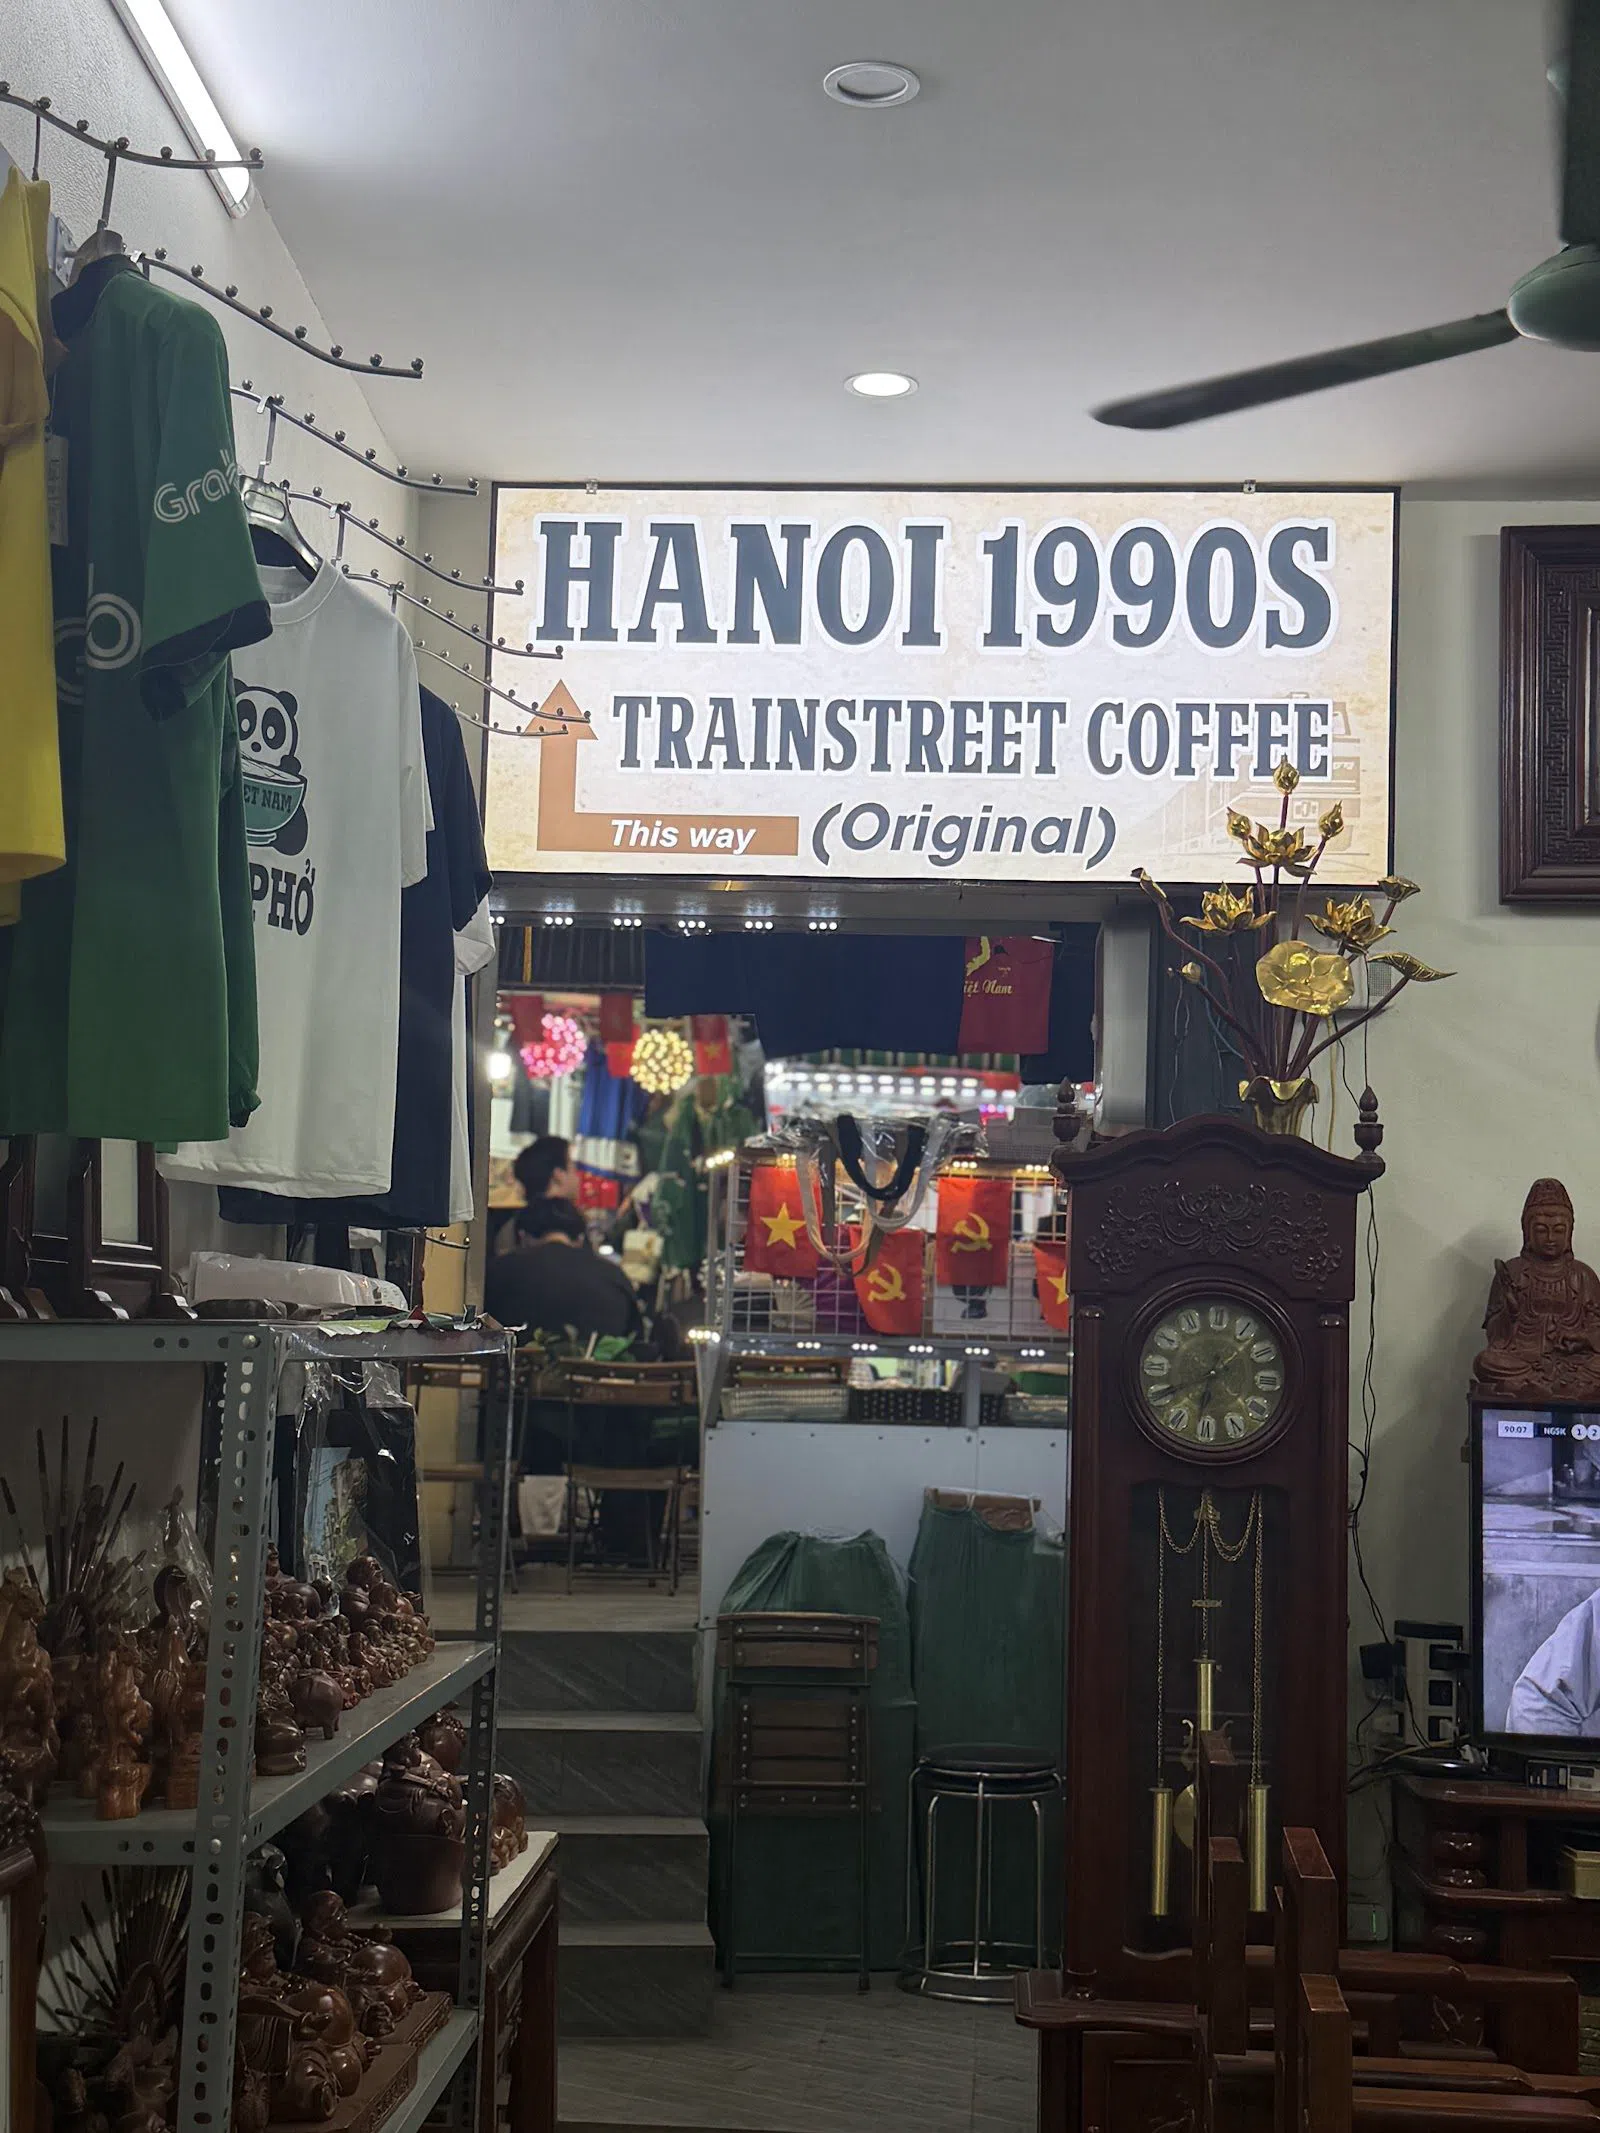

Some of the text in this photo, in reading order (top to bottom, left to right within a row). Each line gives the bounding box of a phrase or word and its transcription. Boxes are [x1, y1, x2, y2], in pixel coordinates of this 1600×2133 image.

[536, 521, 1332, 650] HANOI 1990S
[613, 695, 1329, 777] TRAINSTREET COFFEE
[261, 789, 293, 814] NAM
[610, 819, 757, 855] This way
[812, 802, 1117, 871] (Original)
[982, 980, 1013, 994] Nam
